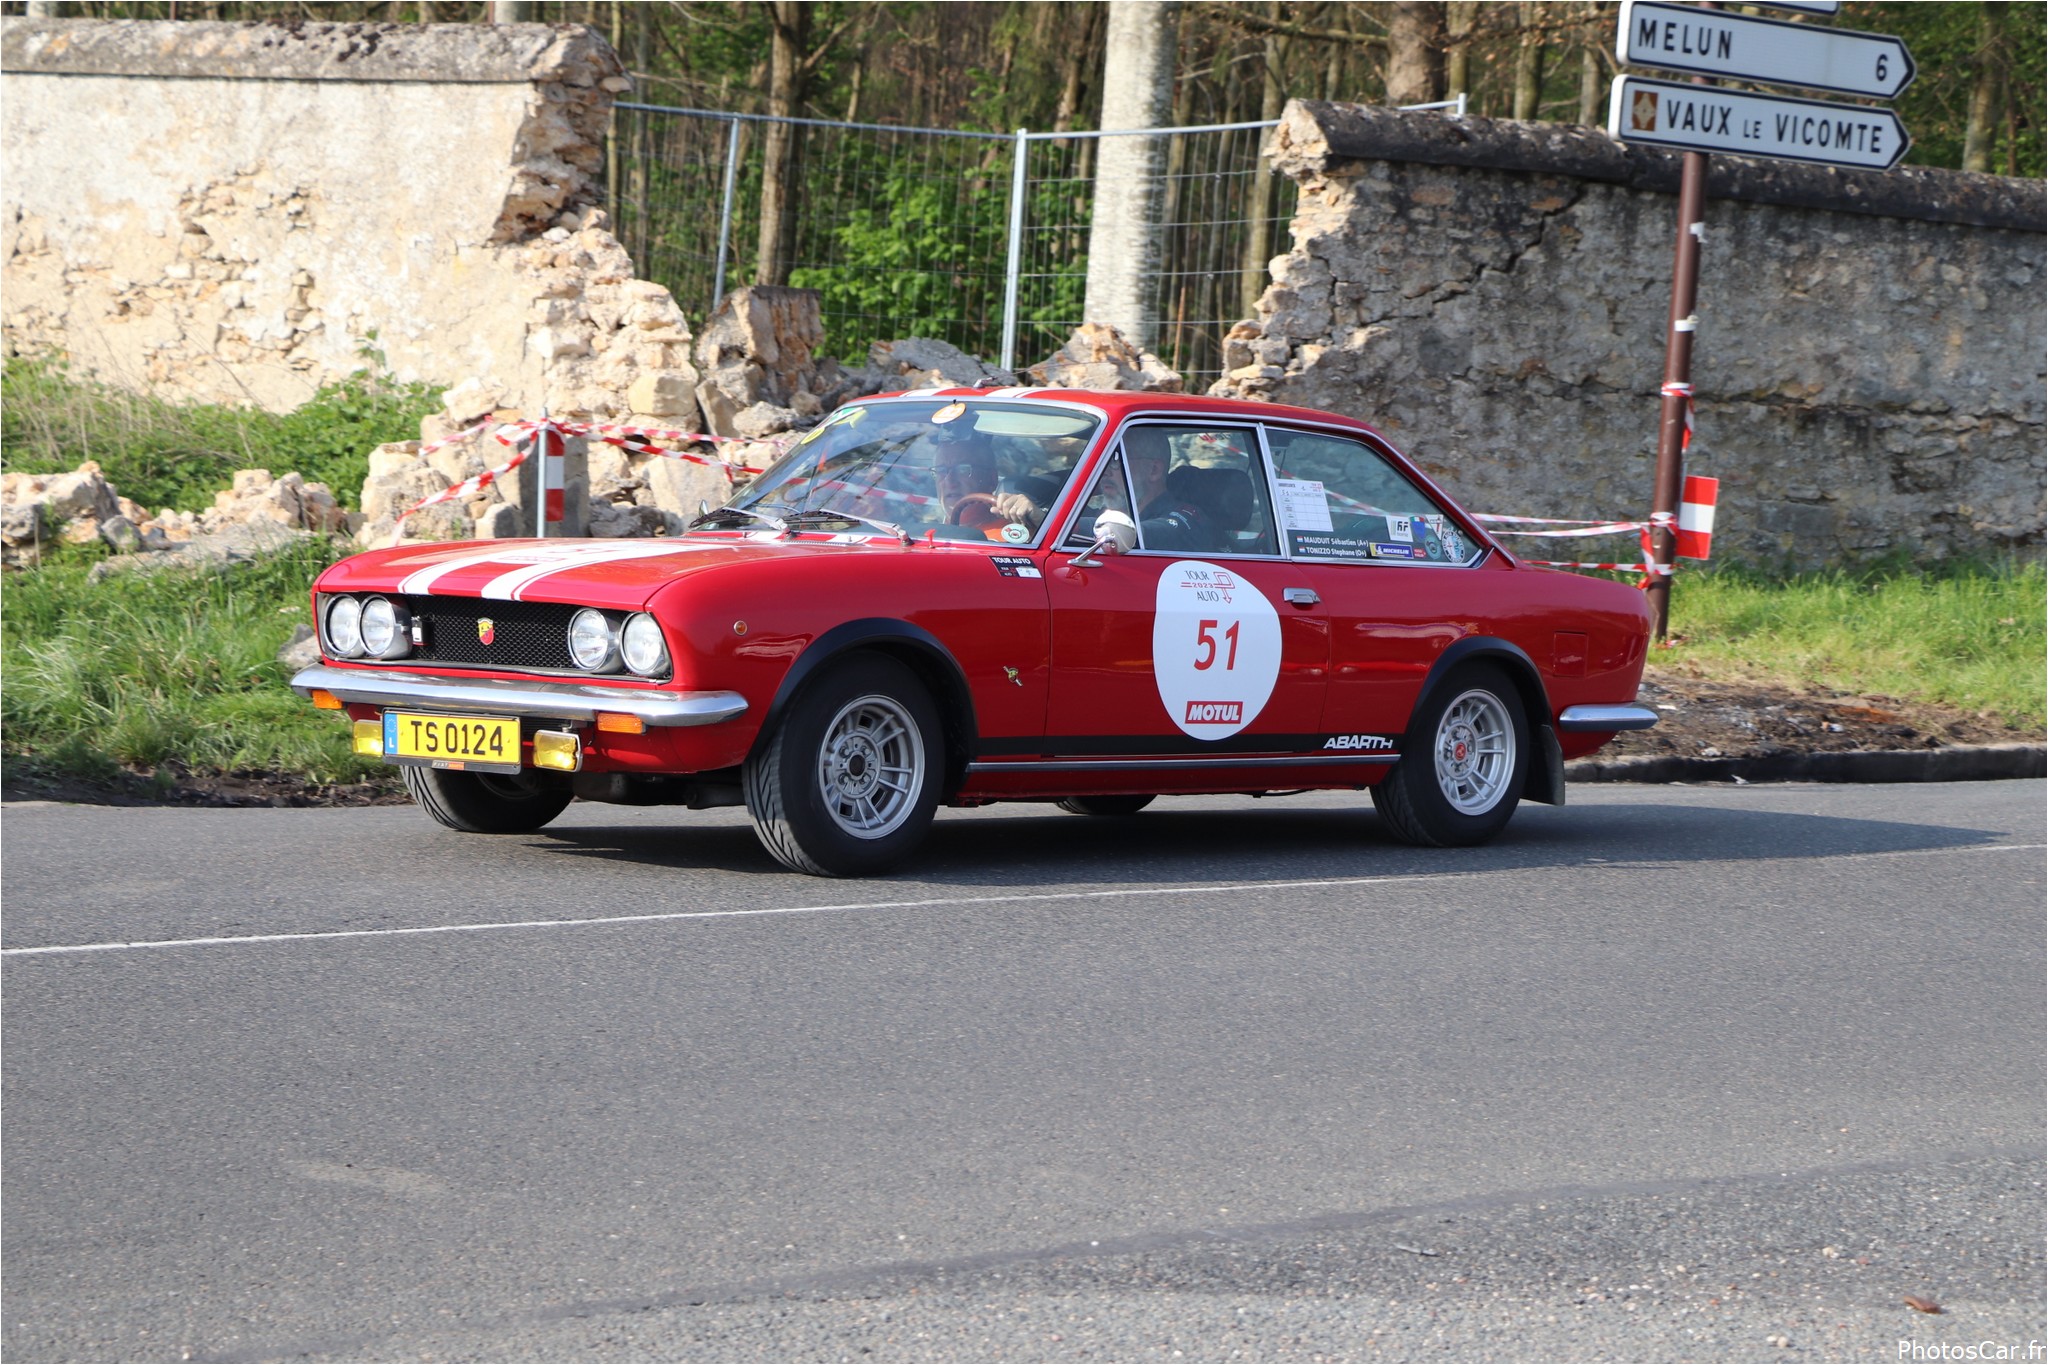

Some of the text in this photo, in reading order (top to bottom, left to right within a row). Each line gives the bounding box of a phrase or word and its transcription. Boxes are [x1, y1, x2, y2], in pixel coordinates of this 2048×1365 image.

[1637, 18, 1889, 82] MELUN 6
[1667, 99, 1883, 154] VAUX LE VICOMTE
[1304, 536, 1330, 545] MAUDUIT
[1012, 557, 1031, 565] AUTO
[1184, 570, 1210, 581] TOUR
[1196, 590, 1220, 602] AUTO
[1193, 619, 1240, 671] 51
[1187, 704, 1240, 721] MOTUL
[389, 737, 395, 748] L
[410, 720, 504, 757] TS 0124
[1323, 735, 1394, 749] ABARTH
